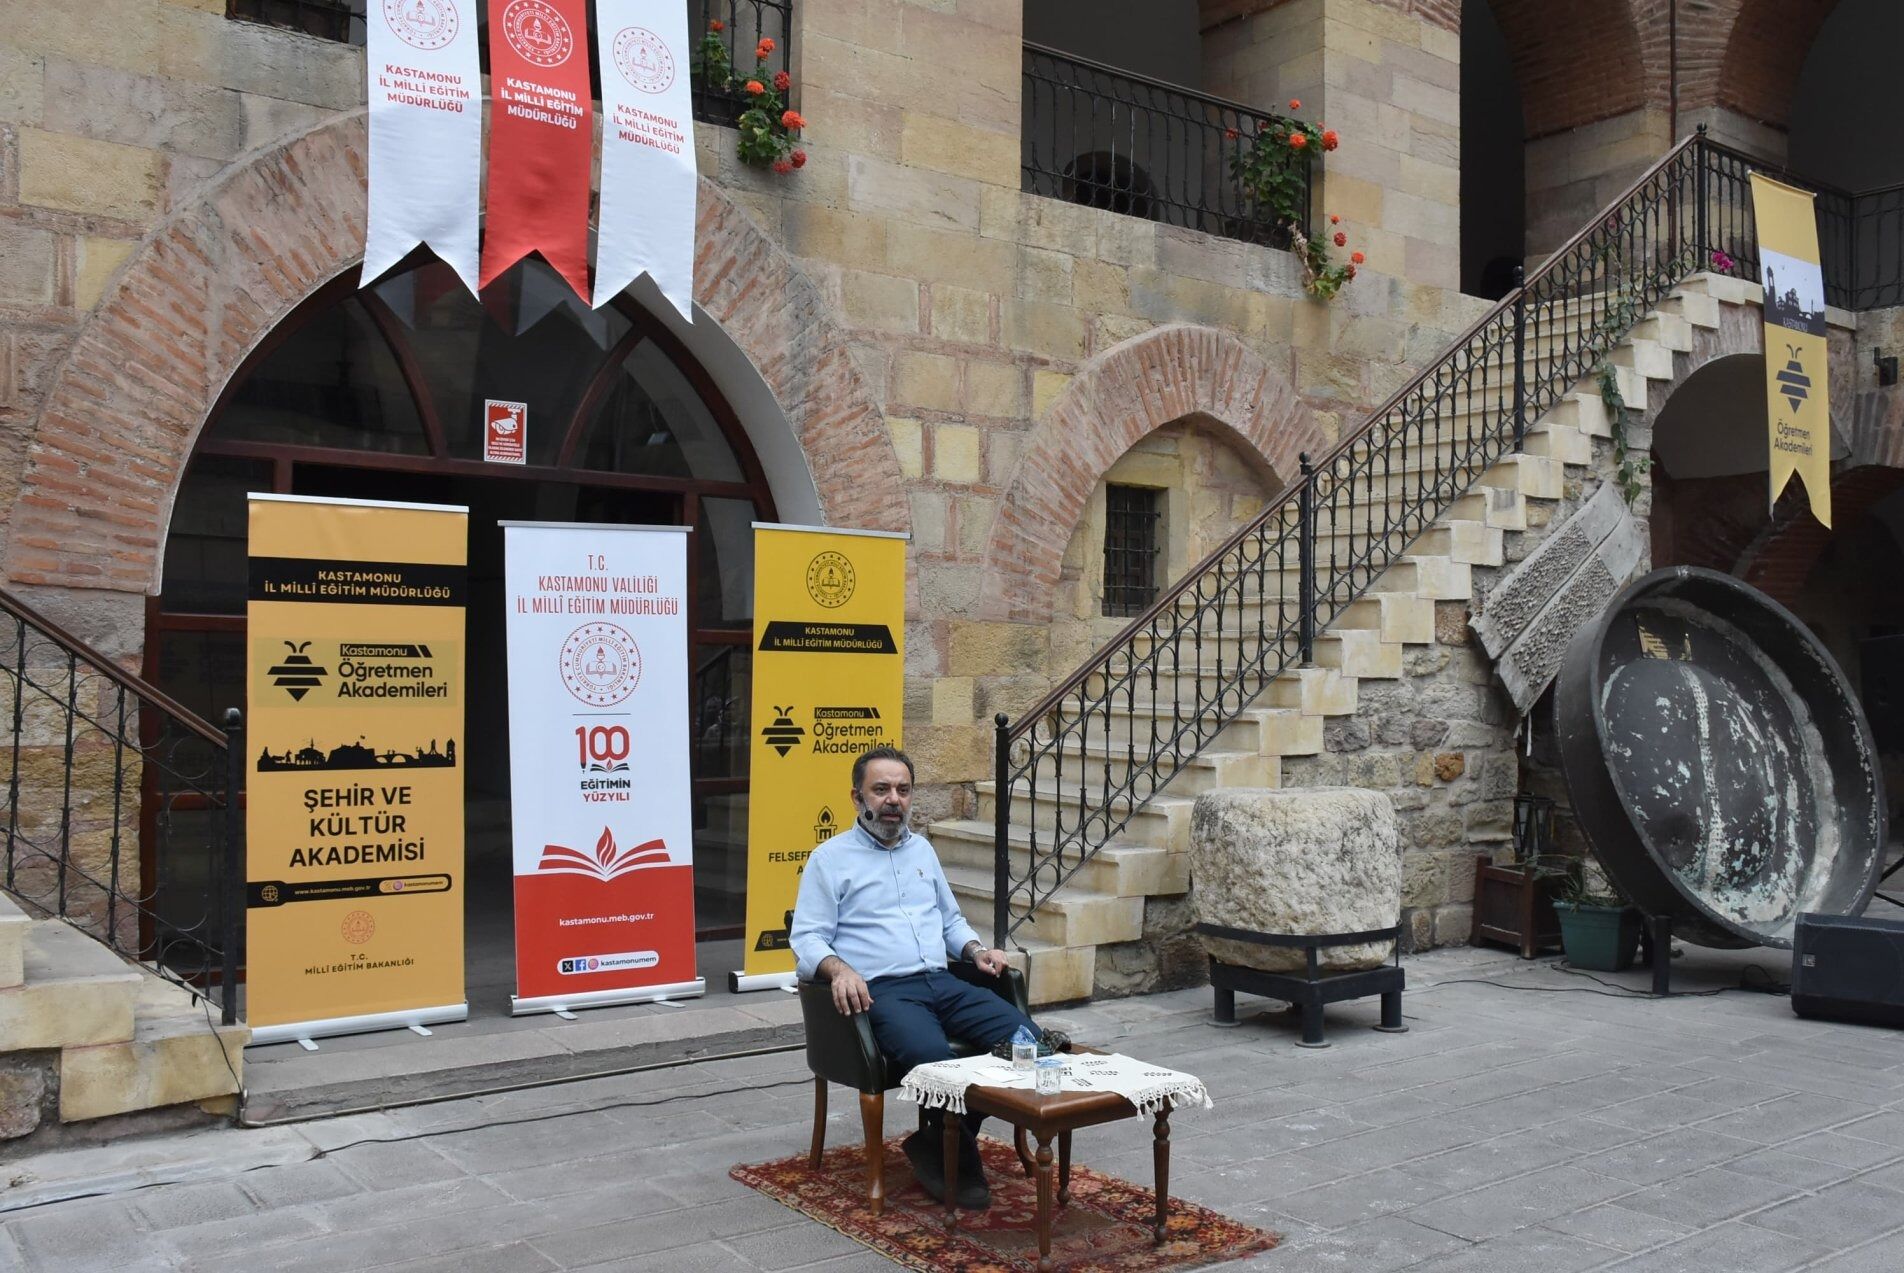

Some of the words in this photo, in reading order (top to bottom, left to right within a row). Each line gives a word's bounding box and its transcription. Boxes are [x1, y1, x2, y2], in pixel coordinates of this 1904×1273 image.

[385, 64, 462, 85] KASTAMONU
[379, 74, 390, 87] İL
[429, 85, 470, 99] EĞİTİM
[506, 77, 576, 102] KASTAMONU
[387, 92, 463, 113] MÜDÜRLÜĞÜ
[501, 87, 512, 100] İL
[546, 99, 583, 117] EĞİTİM
[507, 104, 577, 129] MÜDÜRLÜĞÜ
[617, 103, 678, 129] KASTAMONU
[613, 113, 622, 125] İL
[652, 127, 685, 143] EĞİTİM
[618, 130, 680, 154] MÜDÜRLÜĞÜ
[1777, 418, 1811, 440] Öğretmen
[588, 554, 609, 571] T.C.
[318, 570, 402, 583] KASTAMONU
[538, 575, 608, 593] KASTAMONU
[612, 575, 658, 594] VALİLİĞİ
[264, 580, 277, 593] İL
[320, 583, 366, 596] EĞİTİM
[370, 584, 450, 598] MÜDÜRLÜĞÜ
[517, 595, 528, 614] İL
[532, 594, 564, 614] MİLLÎ
[568, 595, 605, 614] EĞİTİM
[610, 596, 678, 616] MÜDÜRLÜĞÜ
[805, 626, 855, 636] KASTAMONU
[341, 644, 408, 657] Kastamonu
[774, 636, 781, 646] İL
[805, 637, 832, 648] EĞİTİM
[833, 638, 883, 649] MÜDÜRLÜĞÜ
[338, 657, 433, 682] Öğretmen
[337, 682, 448, 698] Akademileri
[816, 707, 865, 718] Kastamonu
[813, 719, 883, 740] Öğretmen
[575, 725, 630, 765] 100
[580, 777, 631, 790] EĞİTİMİN
[303, 783, 375, 813] ŞEHİR
[381, 786, 412, 805] VE
[583, 790, 630, 803] YÜZYILI
[309, 811, 406, 837] KÜLTÜR
[289, 837, 425, 868] AKADEMİSİ
[559, 911, 655, 927] kastamonu.meb.gov.tr
[332, 961, 364, 973] EĞİTİM
[366, 957, 414, 970] BAKANLIĞI
[350, 953, 369, 961] T.C.
[600, 956, 657, 967] kastamonumem
